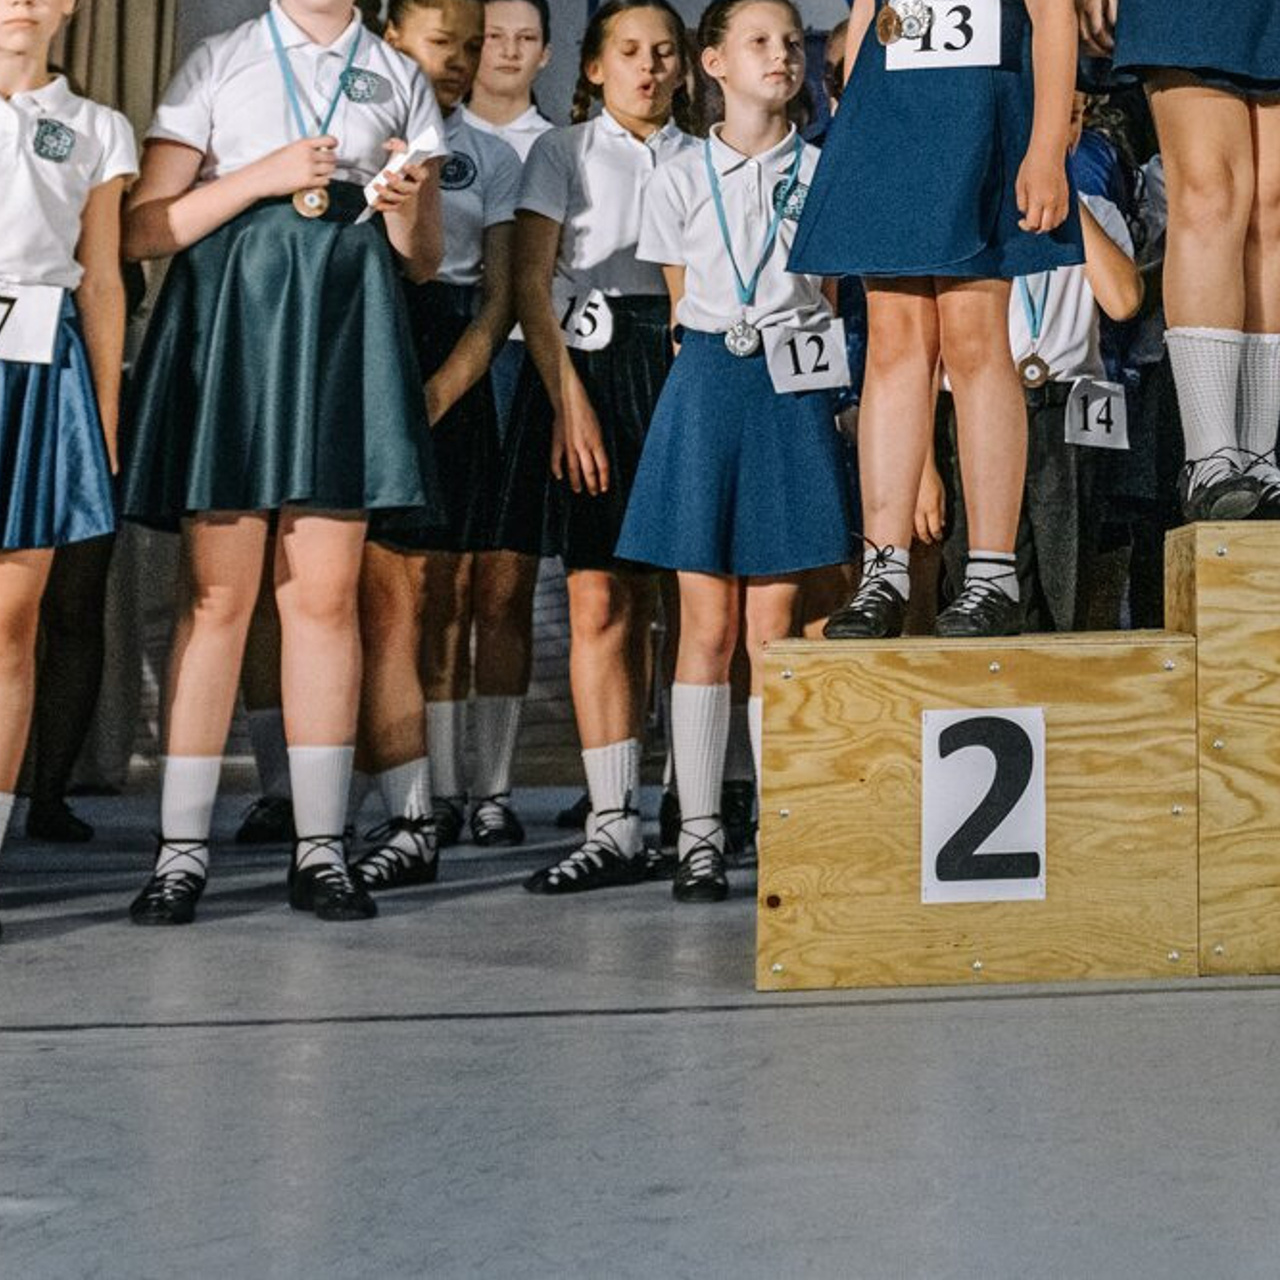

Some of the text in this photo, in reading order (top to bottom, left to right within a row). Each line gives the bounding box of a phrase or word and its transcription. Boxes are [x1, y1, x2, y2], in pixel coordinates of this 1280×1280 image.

[914, 4, 974, 52] 13
[560, 295, 600, 338] 15
[784, 334, 830, 376] 12
[1080, 393, 1114, 434] 14
[936, 716, 1041, 882] 2
